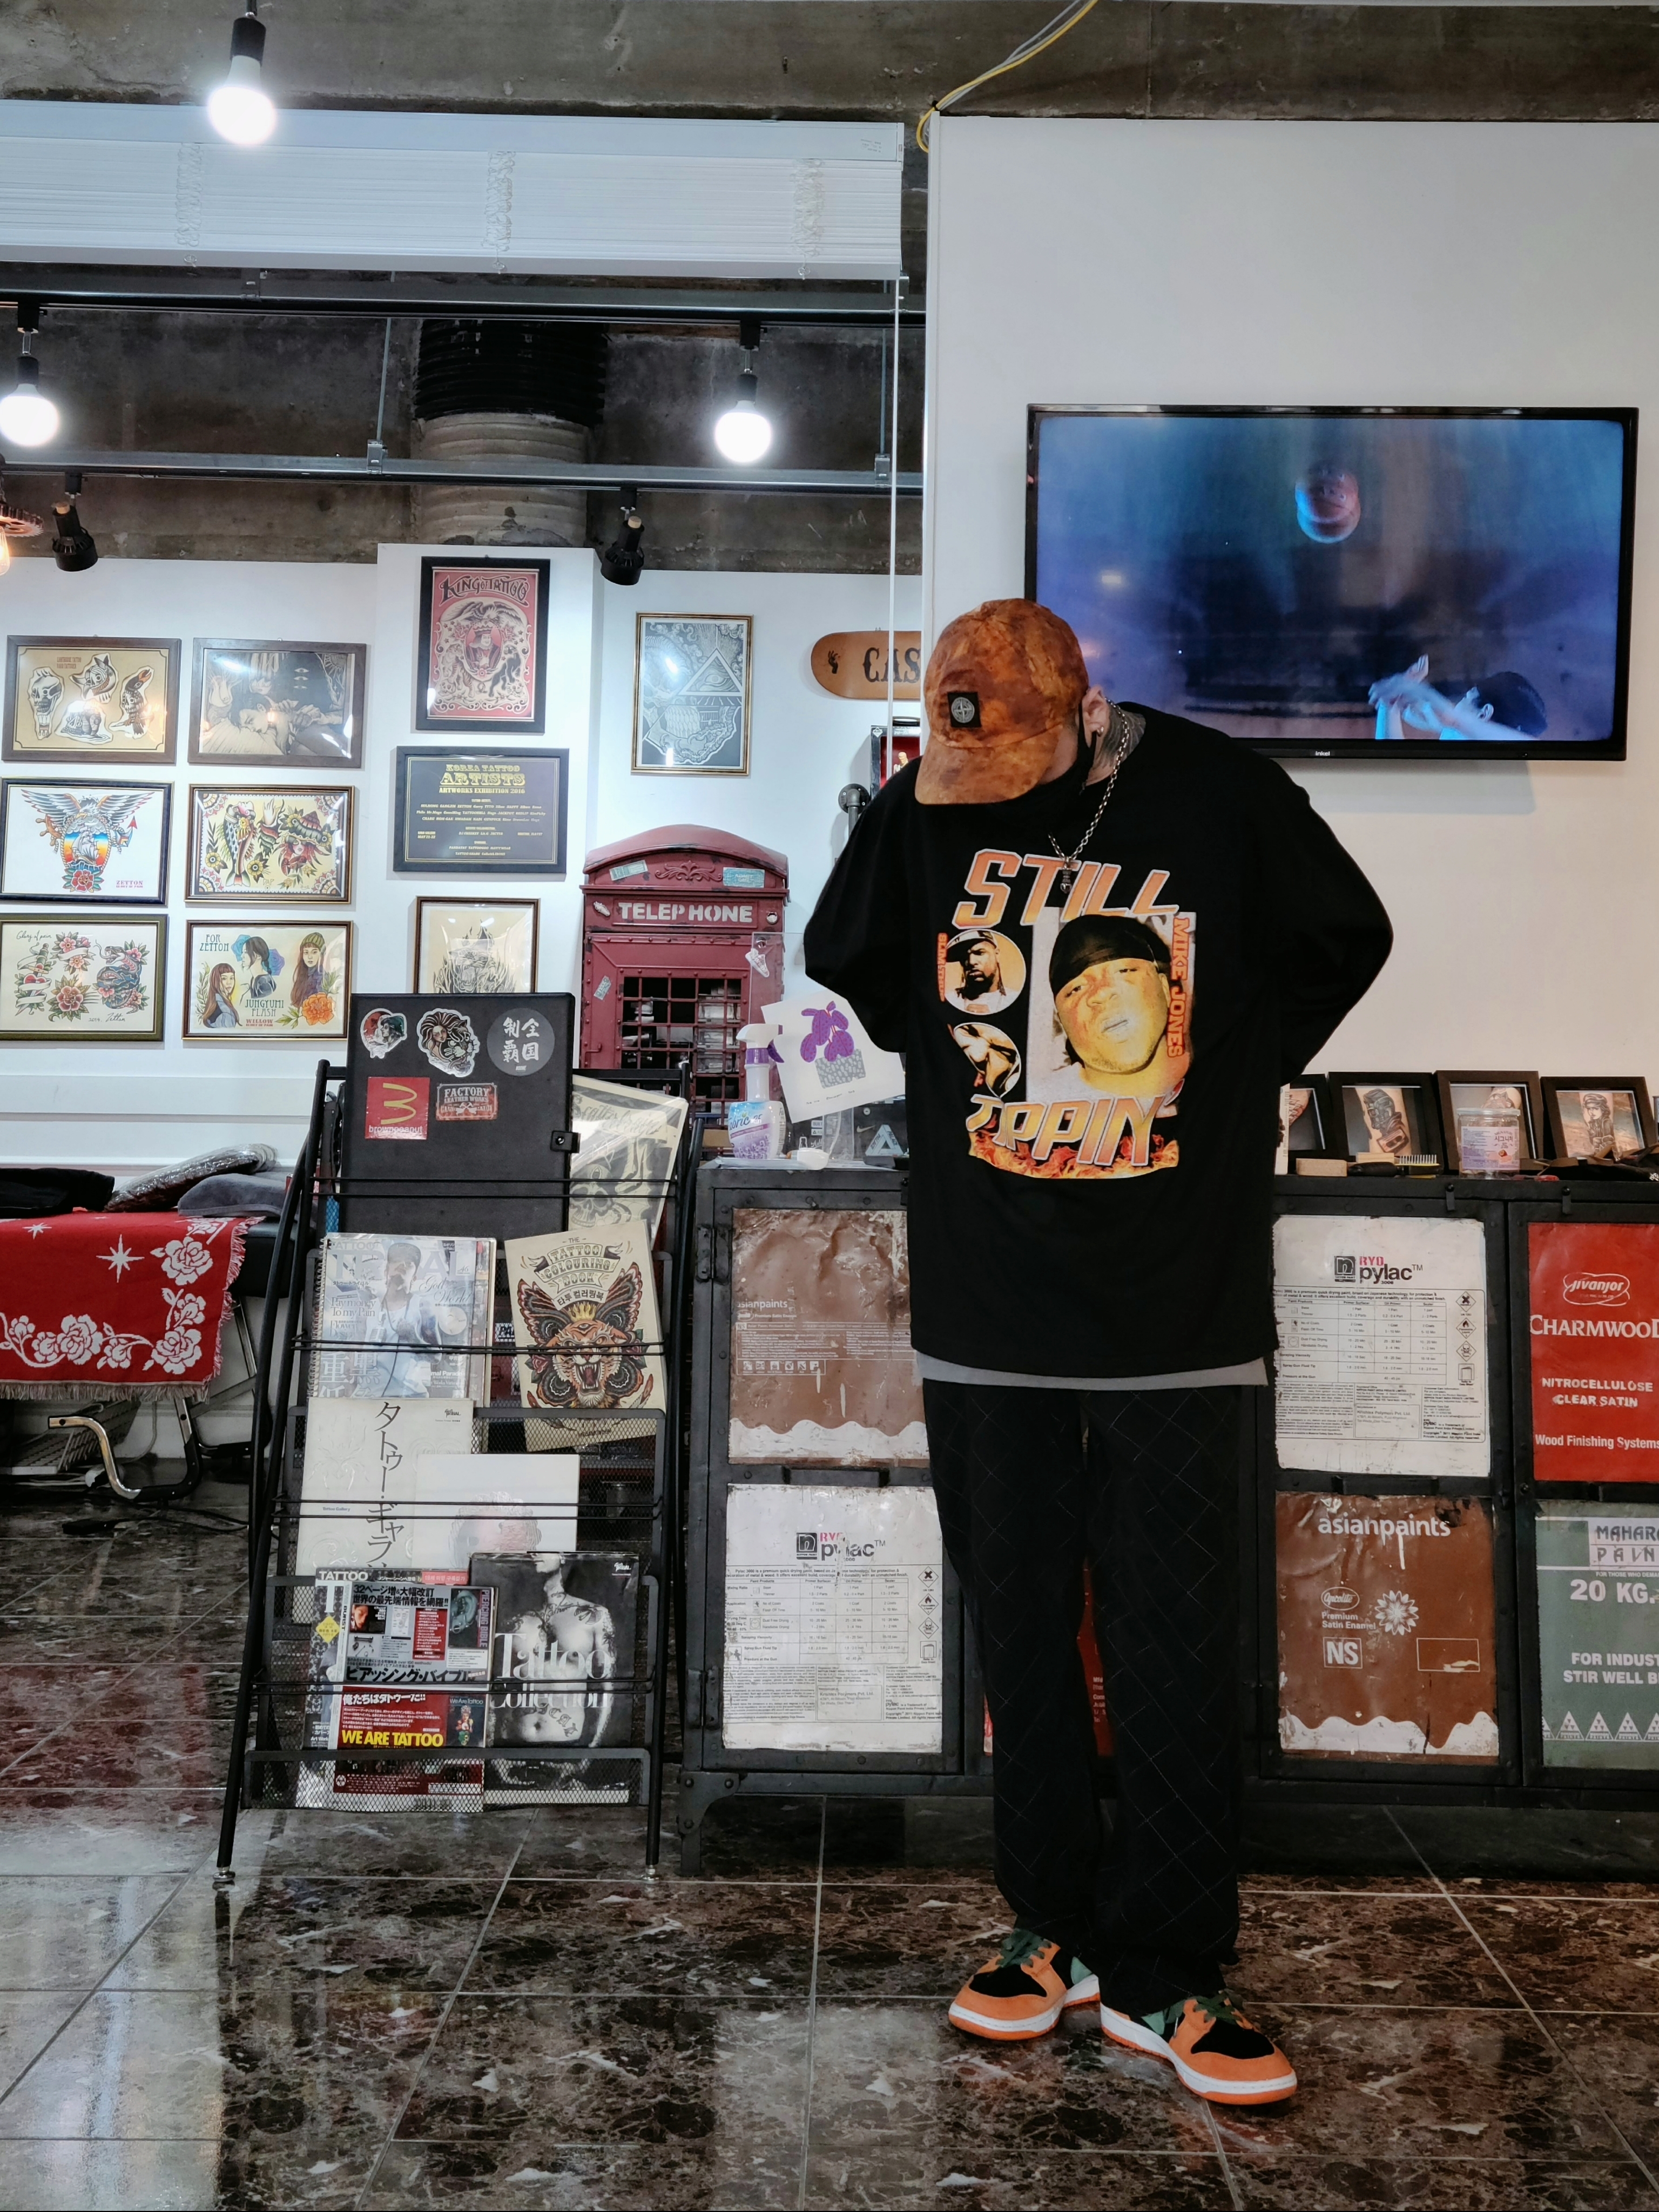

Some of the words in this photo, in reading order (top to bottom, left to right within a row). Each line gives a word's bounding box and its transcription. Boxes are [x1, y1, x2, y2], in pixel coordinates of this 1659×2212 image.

[440, 575, 481, 606] KING
[482, 575, 529, 602] TATTOO
[862, 647, 921, 683] CAS
[440, 772, 525, 786] ARTISTS
[952, 848, 1179, 930] STILL
[618, 902, 753, 923] TELEPHONE
[206, 934, 221, 943] FOR
[199, 942, 229, 952] ZETTON
[1173, 917, 1190, 982] MIKE
[245, 999, 284, 1008] JUNGYUMI
[252, 1008, 276, 1017] FLASH
[1167, 984, 1186, 1058] JONES
[521, 1018, 539, 1061] 全国
[444, 1087, 489, 1097] FACTORY
[369, 1125, 423, 1135] brownpeanut
[550, 1245, 600, 1262] TATTOO
[543, 1258, 611, 1279] COLOURING
[1360, 1264, 1413, 1284] pylac
[562, 1272, 595, 1286] BOOK
[331, 1297, 347, 1307] Pay
[349, 1299, 377, 1307] money
[557, 1293, 572, 1306] 타투
[331, 1306, 342, 1316] To
[343, 1309, 357, 1319] my
[358, 1306, 376, 1317] Pain
[1542, 1378, 1654, 1393] NITROCELLULOSE
[1553, 1394, 1596, 1405] CLEAR
[1600, 1395, 1638, 1407] SATIN
[1535, 1434, 1564, 1446] Wood
[1567, 1435, 1614, 1449] Finishing
[1318, 1513, 1452, 1539] asianpaints
[319, 1571, 368, 1581] TATTOO
[1570, 1579, 1606, 1602] 20
[1617, 1582, 1656, 1604] KG.
[480, 1589, 490, 1625] PIERCING
[1321, 1612, 1358, 1621] Premium
[1322, 1621, 1344, 1629] Satin
[1345, 1621, 1376, 1630] Enamel
[480, 1626, 488, 1648] BIBLE
[494, 1633, 613, 1681] Tattoo
[1327, 1641, 1359, 1665] NS
[1572, 1653, 1602, 1666] FOR
[1563, 1670, 1599, 1684] STIR
[1602, 1671, 1643, 1685] WELL
[342, 1730, 363, 1745] WE
[363, 1731, 389, 1745] ARE
[392, 1731, 444, 1748] TATTOO
